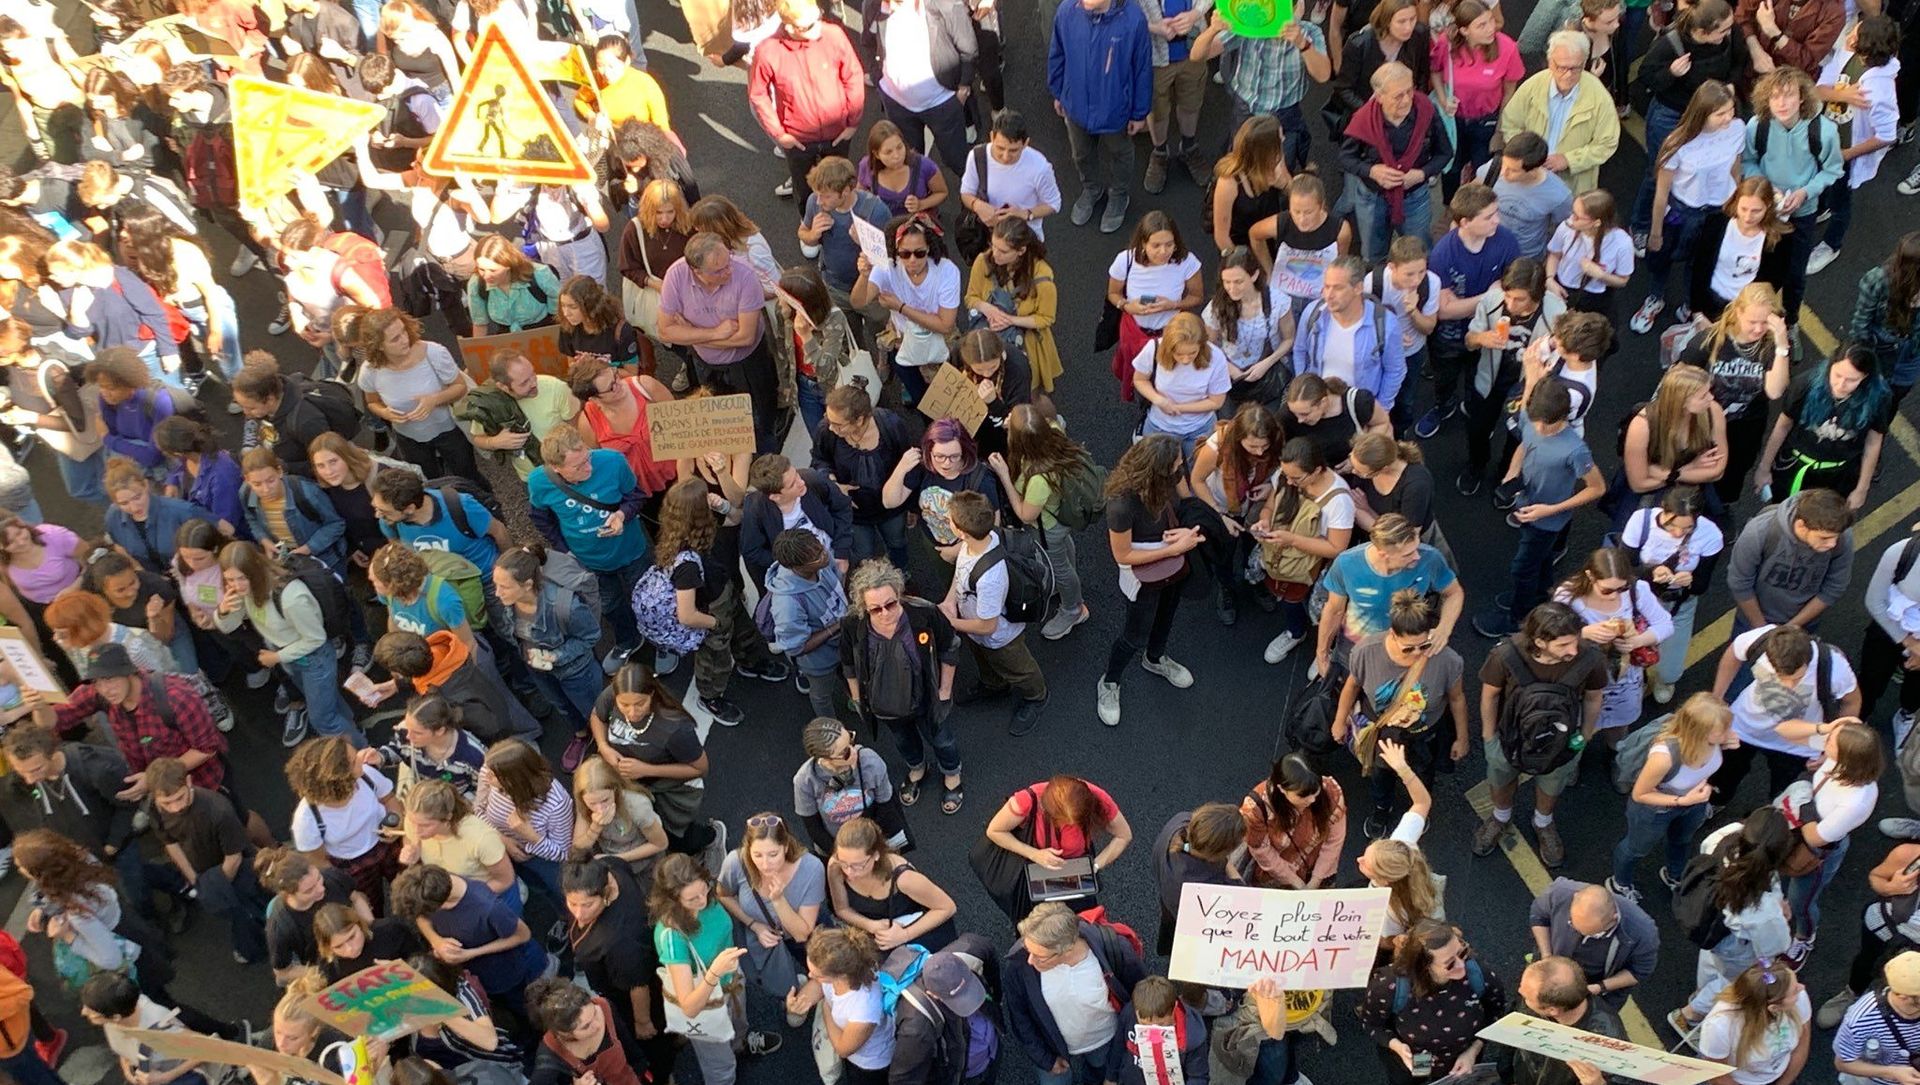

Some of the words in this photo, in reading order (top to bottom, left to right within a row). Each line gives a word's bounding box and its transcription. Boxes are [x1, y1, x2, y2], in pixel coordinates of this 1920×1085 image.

[653, 405, 681, 419] PLUS
[683, 403, 697, 415] DE
[663, 419, 692, 430] DANS
[695, 417, 709, 427] LA
[1197, 894, 1263, 924] Voyez
[1280, 901, 1322, 927] plus
[1332, 901, 1362, 922] loin
[1201, 927, 1233, 943] que
[1244, 922, 1260, 941] le
[1273, 925, 1310, 942] bout
[1317, 926, 1337, 942] de
[1343, 925, 1372, 941] votre
[1219, 946, 1351, 973] MANDAT
